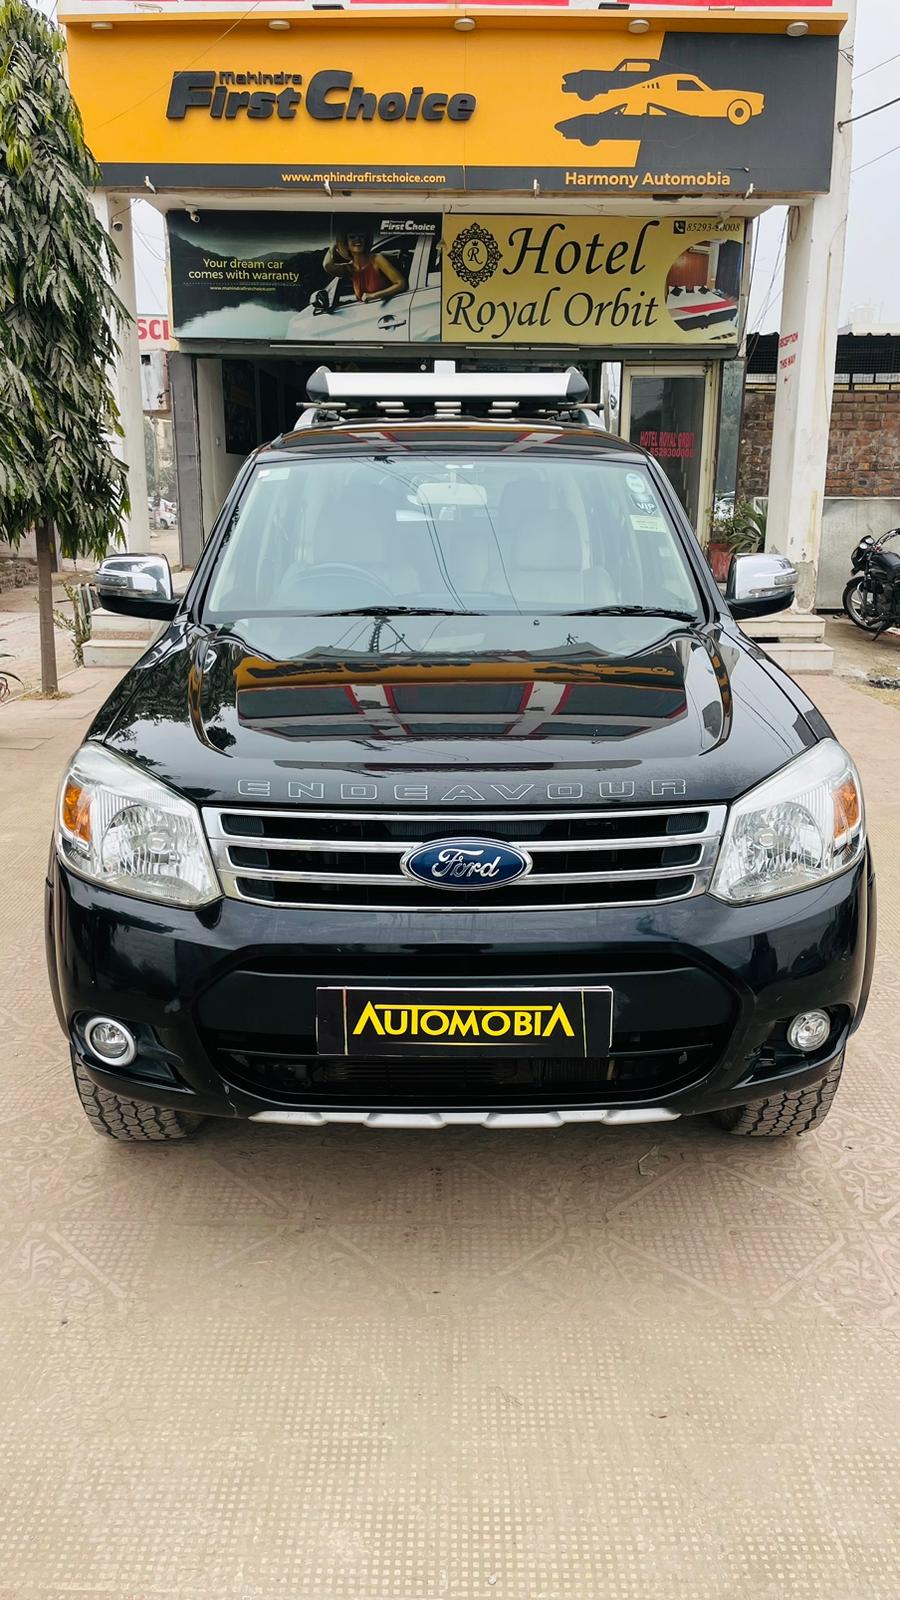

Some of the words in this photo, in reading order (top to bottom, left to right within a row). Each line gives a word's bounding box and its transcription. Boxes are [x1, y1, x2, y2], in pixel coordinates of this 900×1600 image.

[218, 71, 303, 86] Mahindra
[166, 70, 302, 120] First
[305, 69, 477, 121] Choice
[281, 171, 447, 185] www.mahindrafirstchoice.com
[565, 171, 638, 189] Harmony
[642, 171, 731, 186] Automobia
[380, 220, 405, 231] First
[404, 220, 436, 231] Choice
[467, 246, 483, 265] R
[502, 220, 660, 276] Hotel
[203, 258, 227, 269] Your
[229, 259, 265, 270] dream
[267, 261, 284, 270] car
[188, 270, 223, 280] comes
[225, 269, 250, 281] with
[252, 271, 300, 283] warranty
[446, 286, 561, 339] Royal
[563, 287, 659, 327] Orbit
[637, 502, 655, 510] VIP
[237, 778, 688, 802] ENDEAVOUR
[432, 848, 501, 878] Ford
[352, 1001, 575, 1038] AUTOMOBIA
